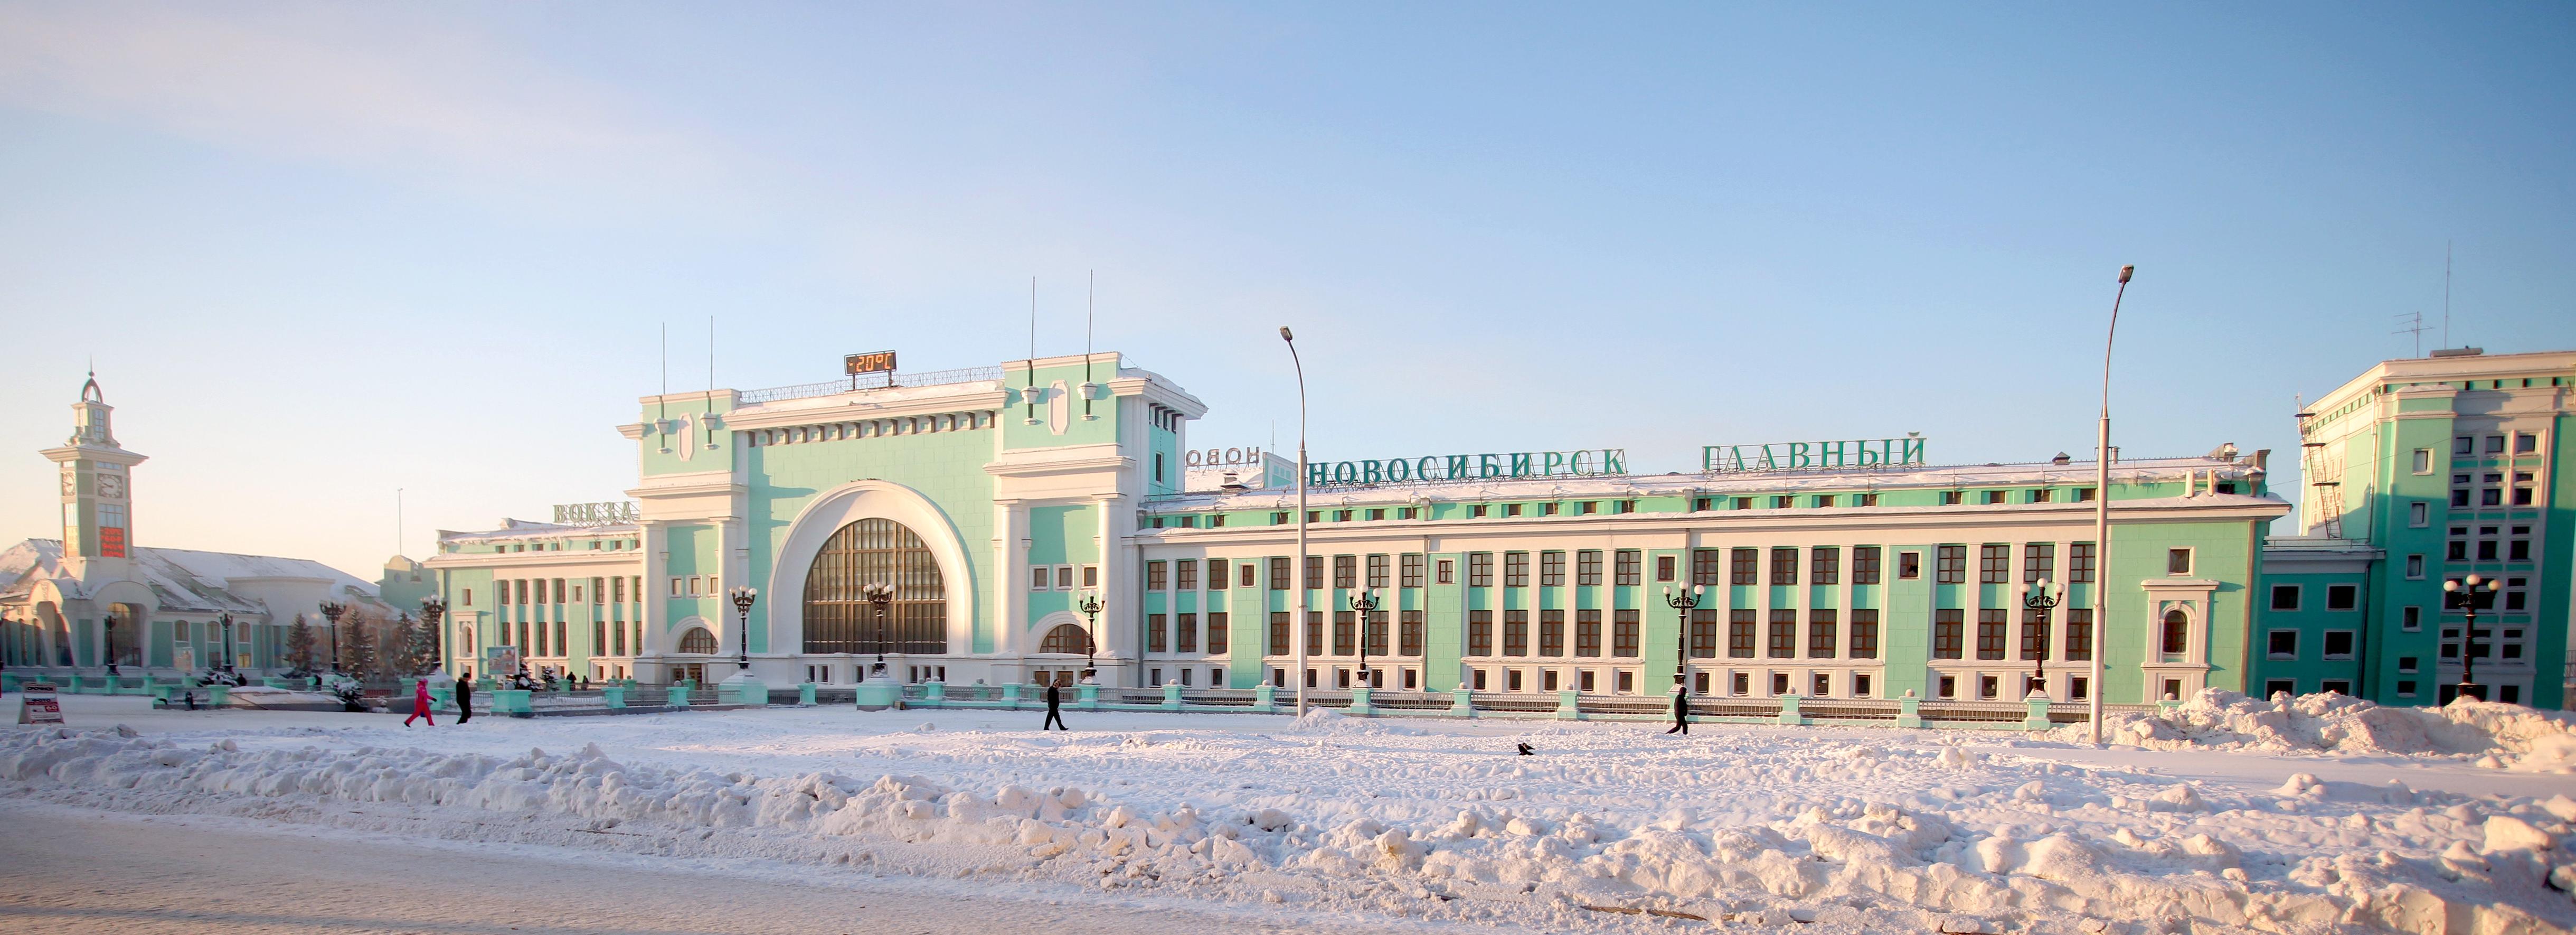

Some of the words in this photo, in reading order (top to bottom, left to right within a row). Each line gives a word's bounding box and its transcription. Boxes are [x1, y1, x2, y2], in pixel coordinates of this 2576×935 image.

[1307, 449, 1626, 487] НОВОСИБИРСК
[1702, 431, 1928, 471] ГЛАВНЫЙ
[553, 501, 640, 523] ВОКЗА
